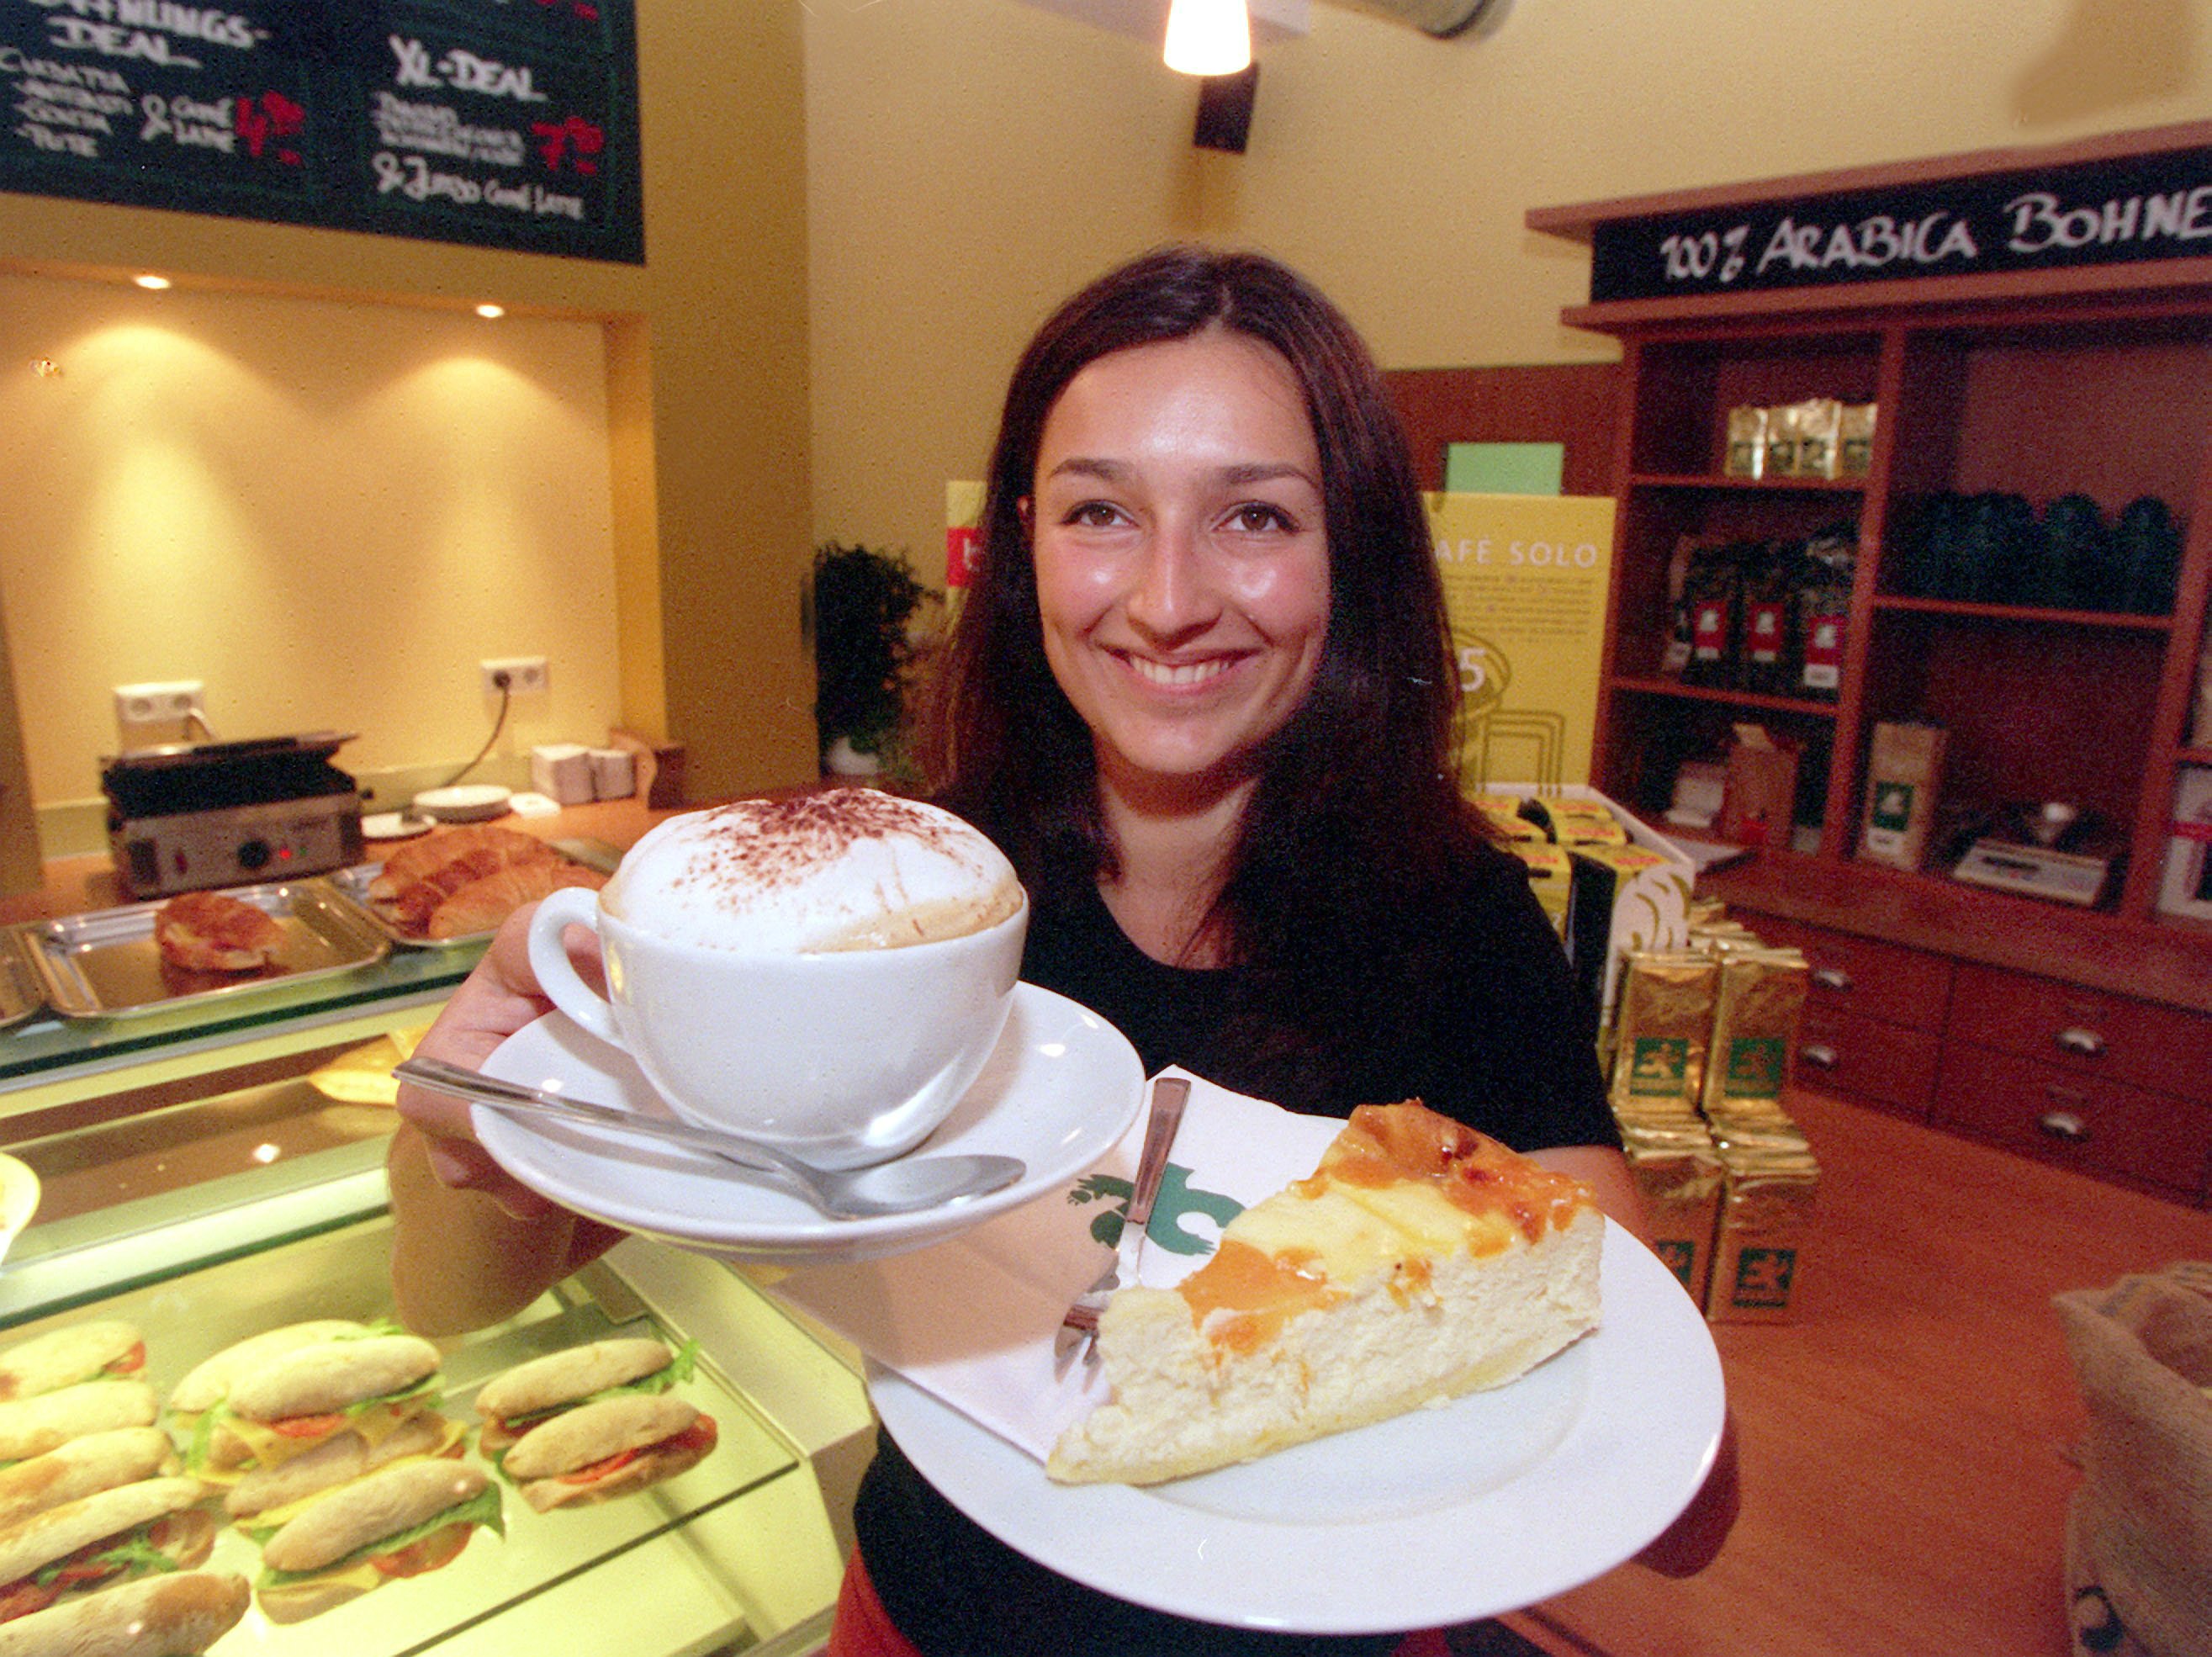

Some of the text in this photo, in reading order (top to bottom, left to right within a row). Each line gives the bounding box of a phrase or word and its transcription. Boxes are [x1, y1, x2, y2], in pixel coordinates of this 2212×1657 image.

[389, 34, 547, 102] XL-DEAL
[1660, 224, 1751, 283] 100%
[1755, 210, 1978, 277] ARABICA
[1435, 534, 1597, 569] AFÉ SOLO
